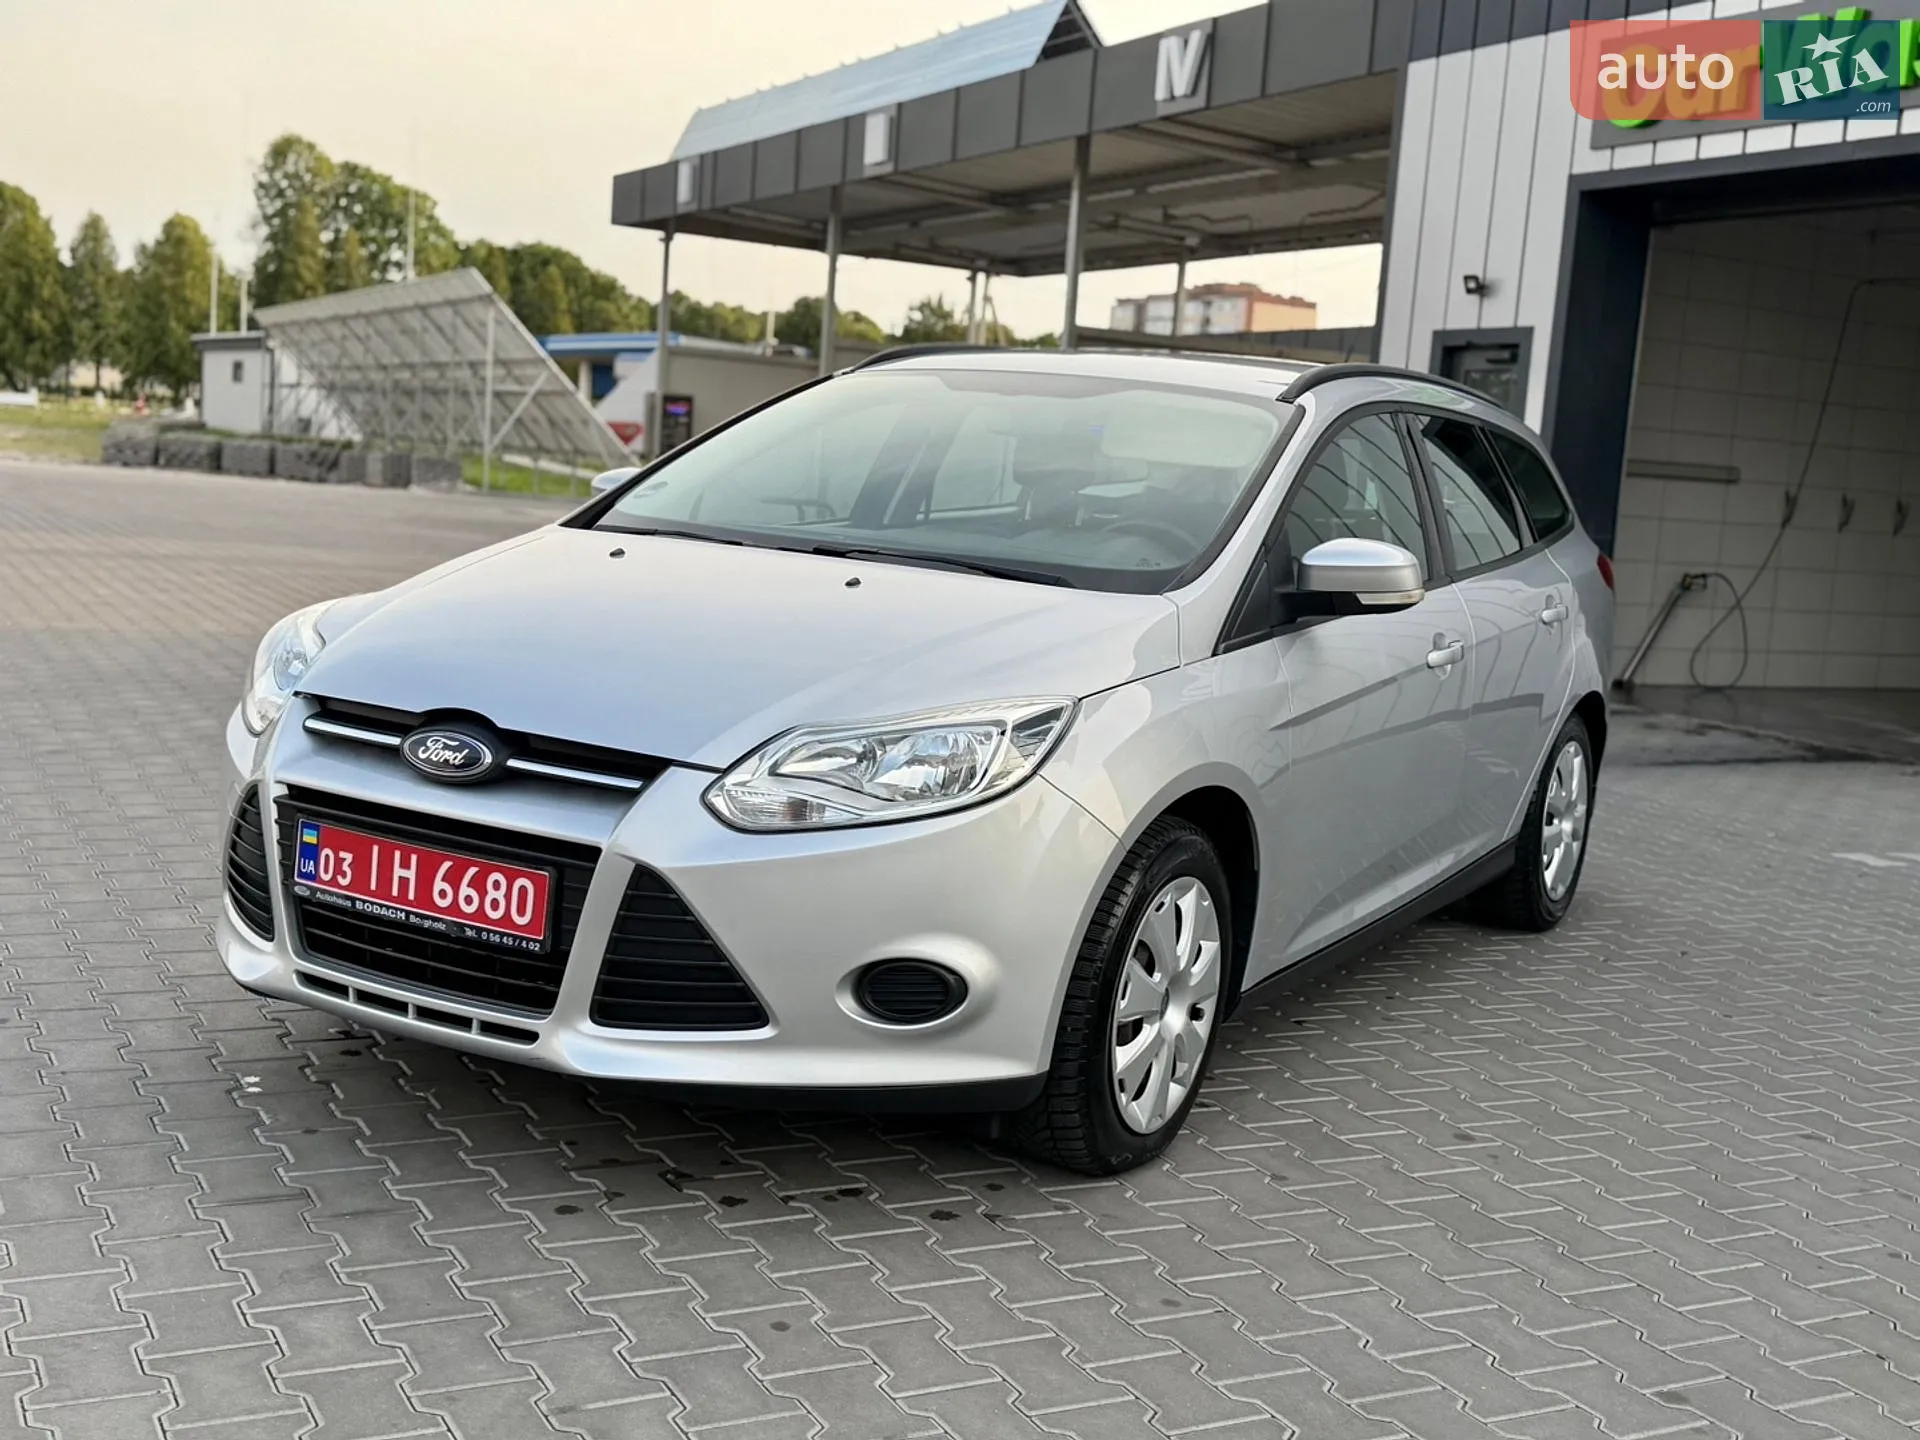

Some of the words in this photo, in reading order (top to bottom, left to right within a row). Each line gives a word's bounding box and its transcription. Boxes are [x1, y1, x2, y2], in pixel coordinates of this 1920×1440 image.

[417, 736, 470, 767] Ford
[300, 857, 316, 875] UA
[318, 847, 354, 887] 03
[369, 844, 418, 901] IH
[431, 860, 535, 927] 6680
[355, 899, 406, 921] BODACH
